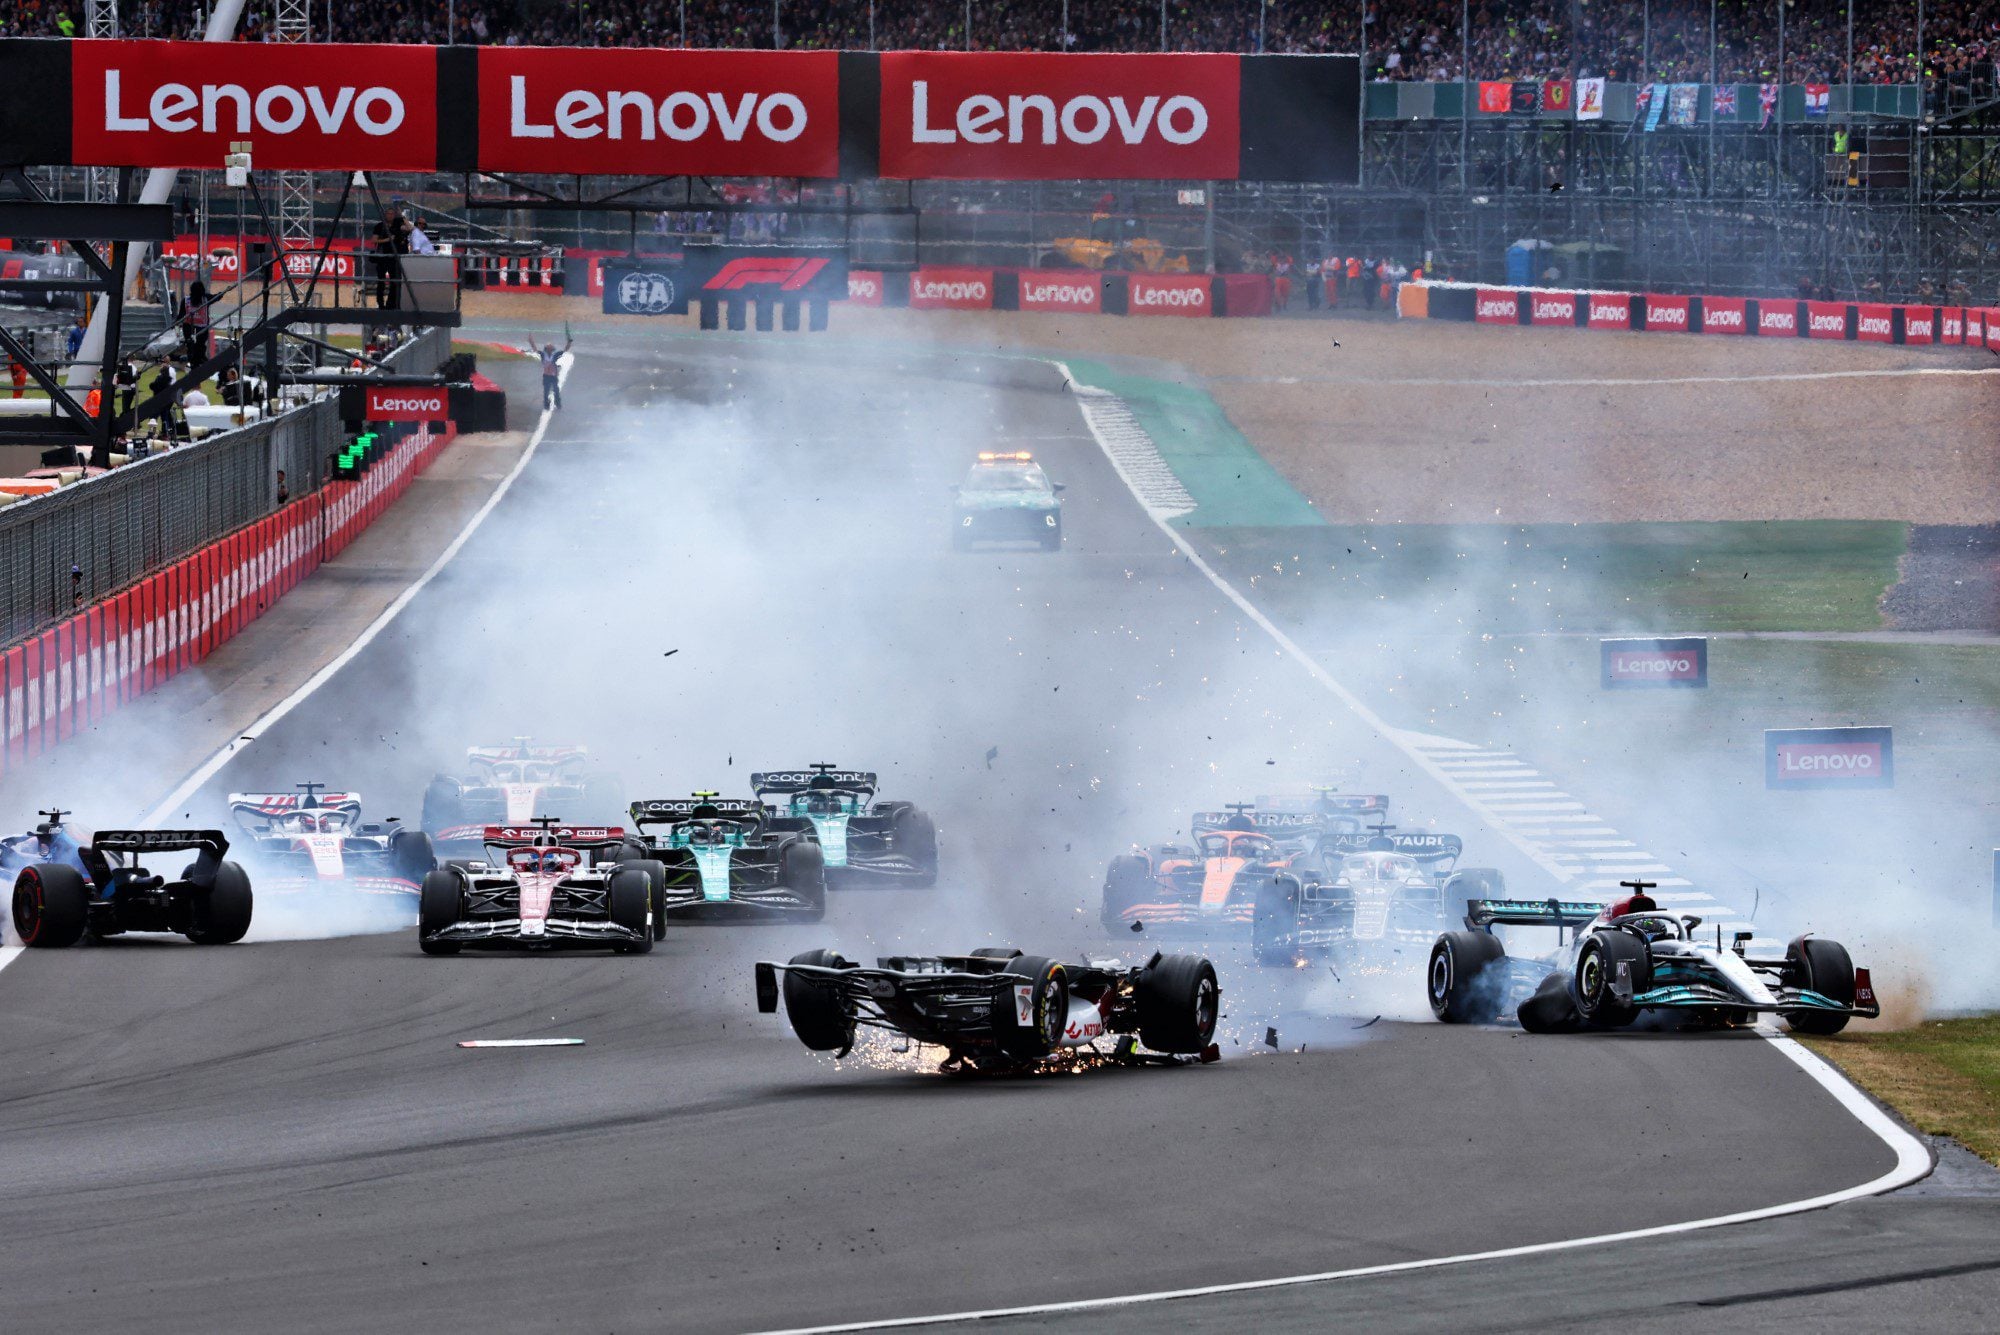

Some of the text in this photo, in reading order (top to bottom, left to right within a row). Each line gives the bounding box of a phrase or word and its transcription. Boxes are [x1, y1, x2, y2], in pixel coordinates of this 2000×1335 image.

[105, 69, 405, 136] Lenovo
[510, 75, 808, 142] Lenovo
[912, 80, 1208, 146] Lenovo
[913, 279, 986, 300] Lenovo
[1024, 281, 1094, 304] Lenovo
[1134, 284, 1204, 306] Lenovo
[1533, 298, 1573, 319] Lenovo
[1647, 304, 1686, 324] Lenovo
[1704, 306, 1743, 326] Lenovo
[1809, 311, 1844, 332] Lenovo
[373, 396, 441, 411] Lenovo
[1617, 657, 1691, 674] Lenovo
[1786, 752, 1872, 771] Lenovo
[106, 831, 202, 848] SOFINA
[1393, 836, 1442, 847] TAURI
